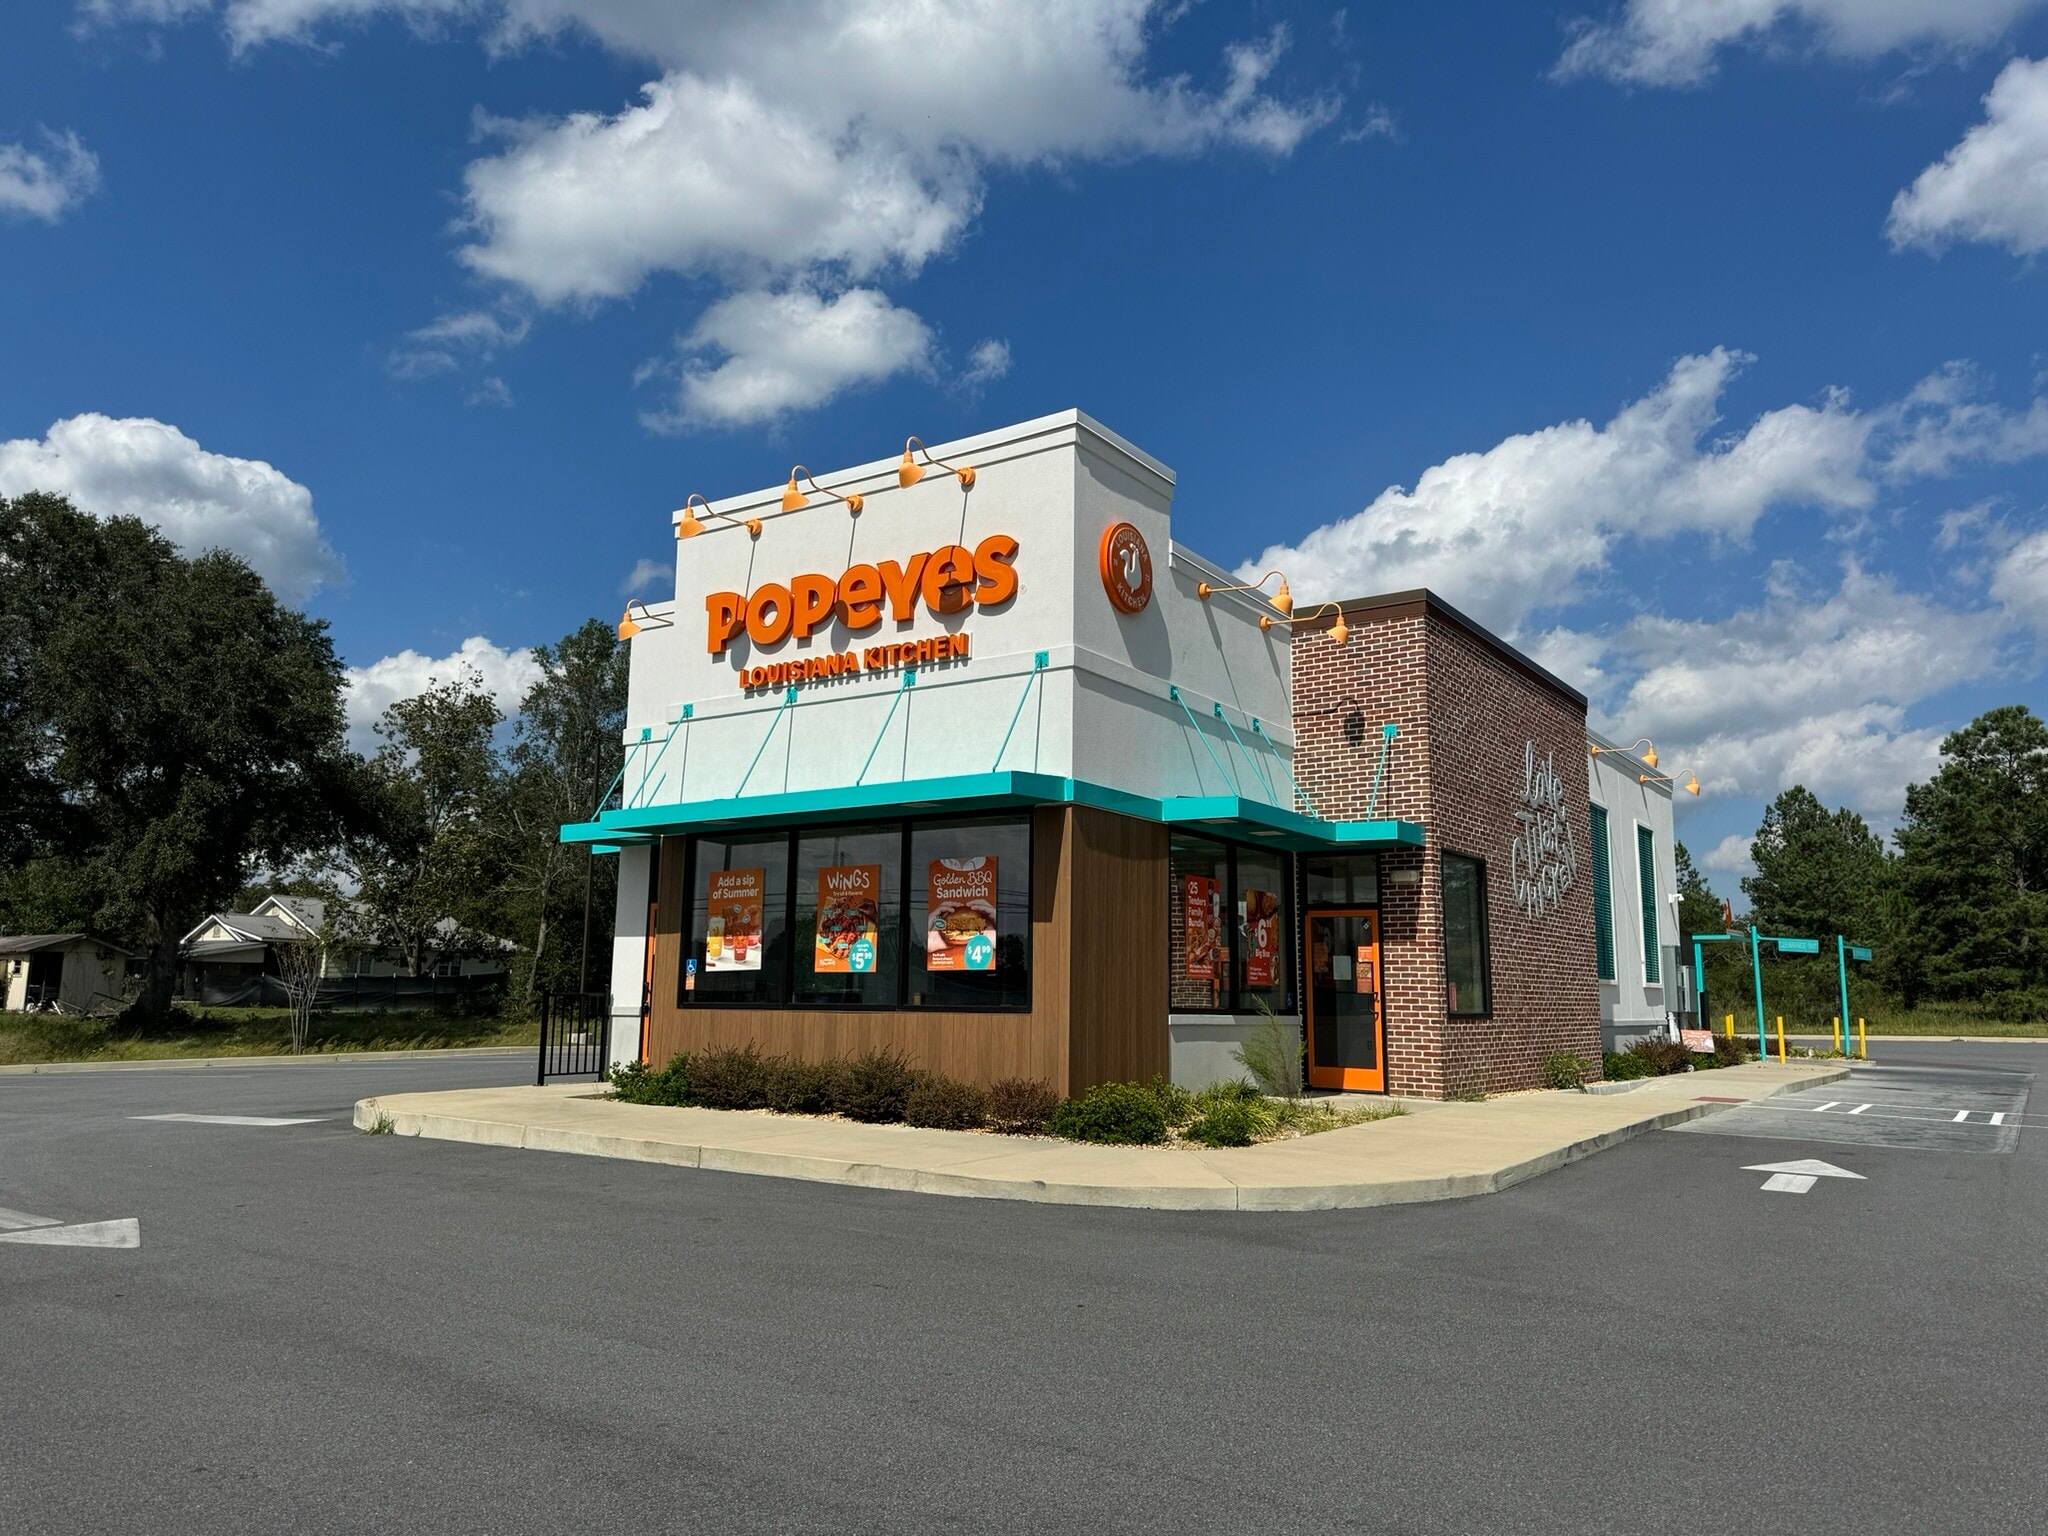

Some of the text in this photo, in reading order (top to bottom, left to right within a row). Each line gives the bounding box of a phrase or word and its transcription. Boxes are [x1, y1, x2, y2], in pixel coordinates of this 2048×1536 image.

[1115, 531, 1148, 562] LOUISIANA
[1117, 582, 1147, 607] KITCHEN
[739, 633, 970, 689] LOUISIANA KITCHEN
[717, 874, 755, 887] Add a sip
[933, 870, 993, 887] Golden BBQ
[712, 887, 760, 899] of Summer
[936, 885, 989, 899] Sandwich
